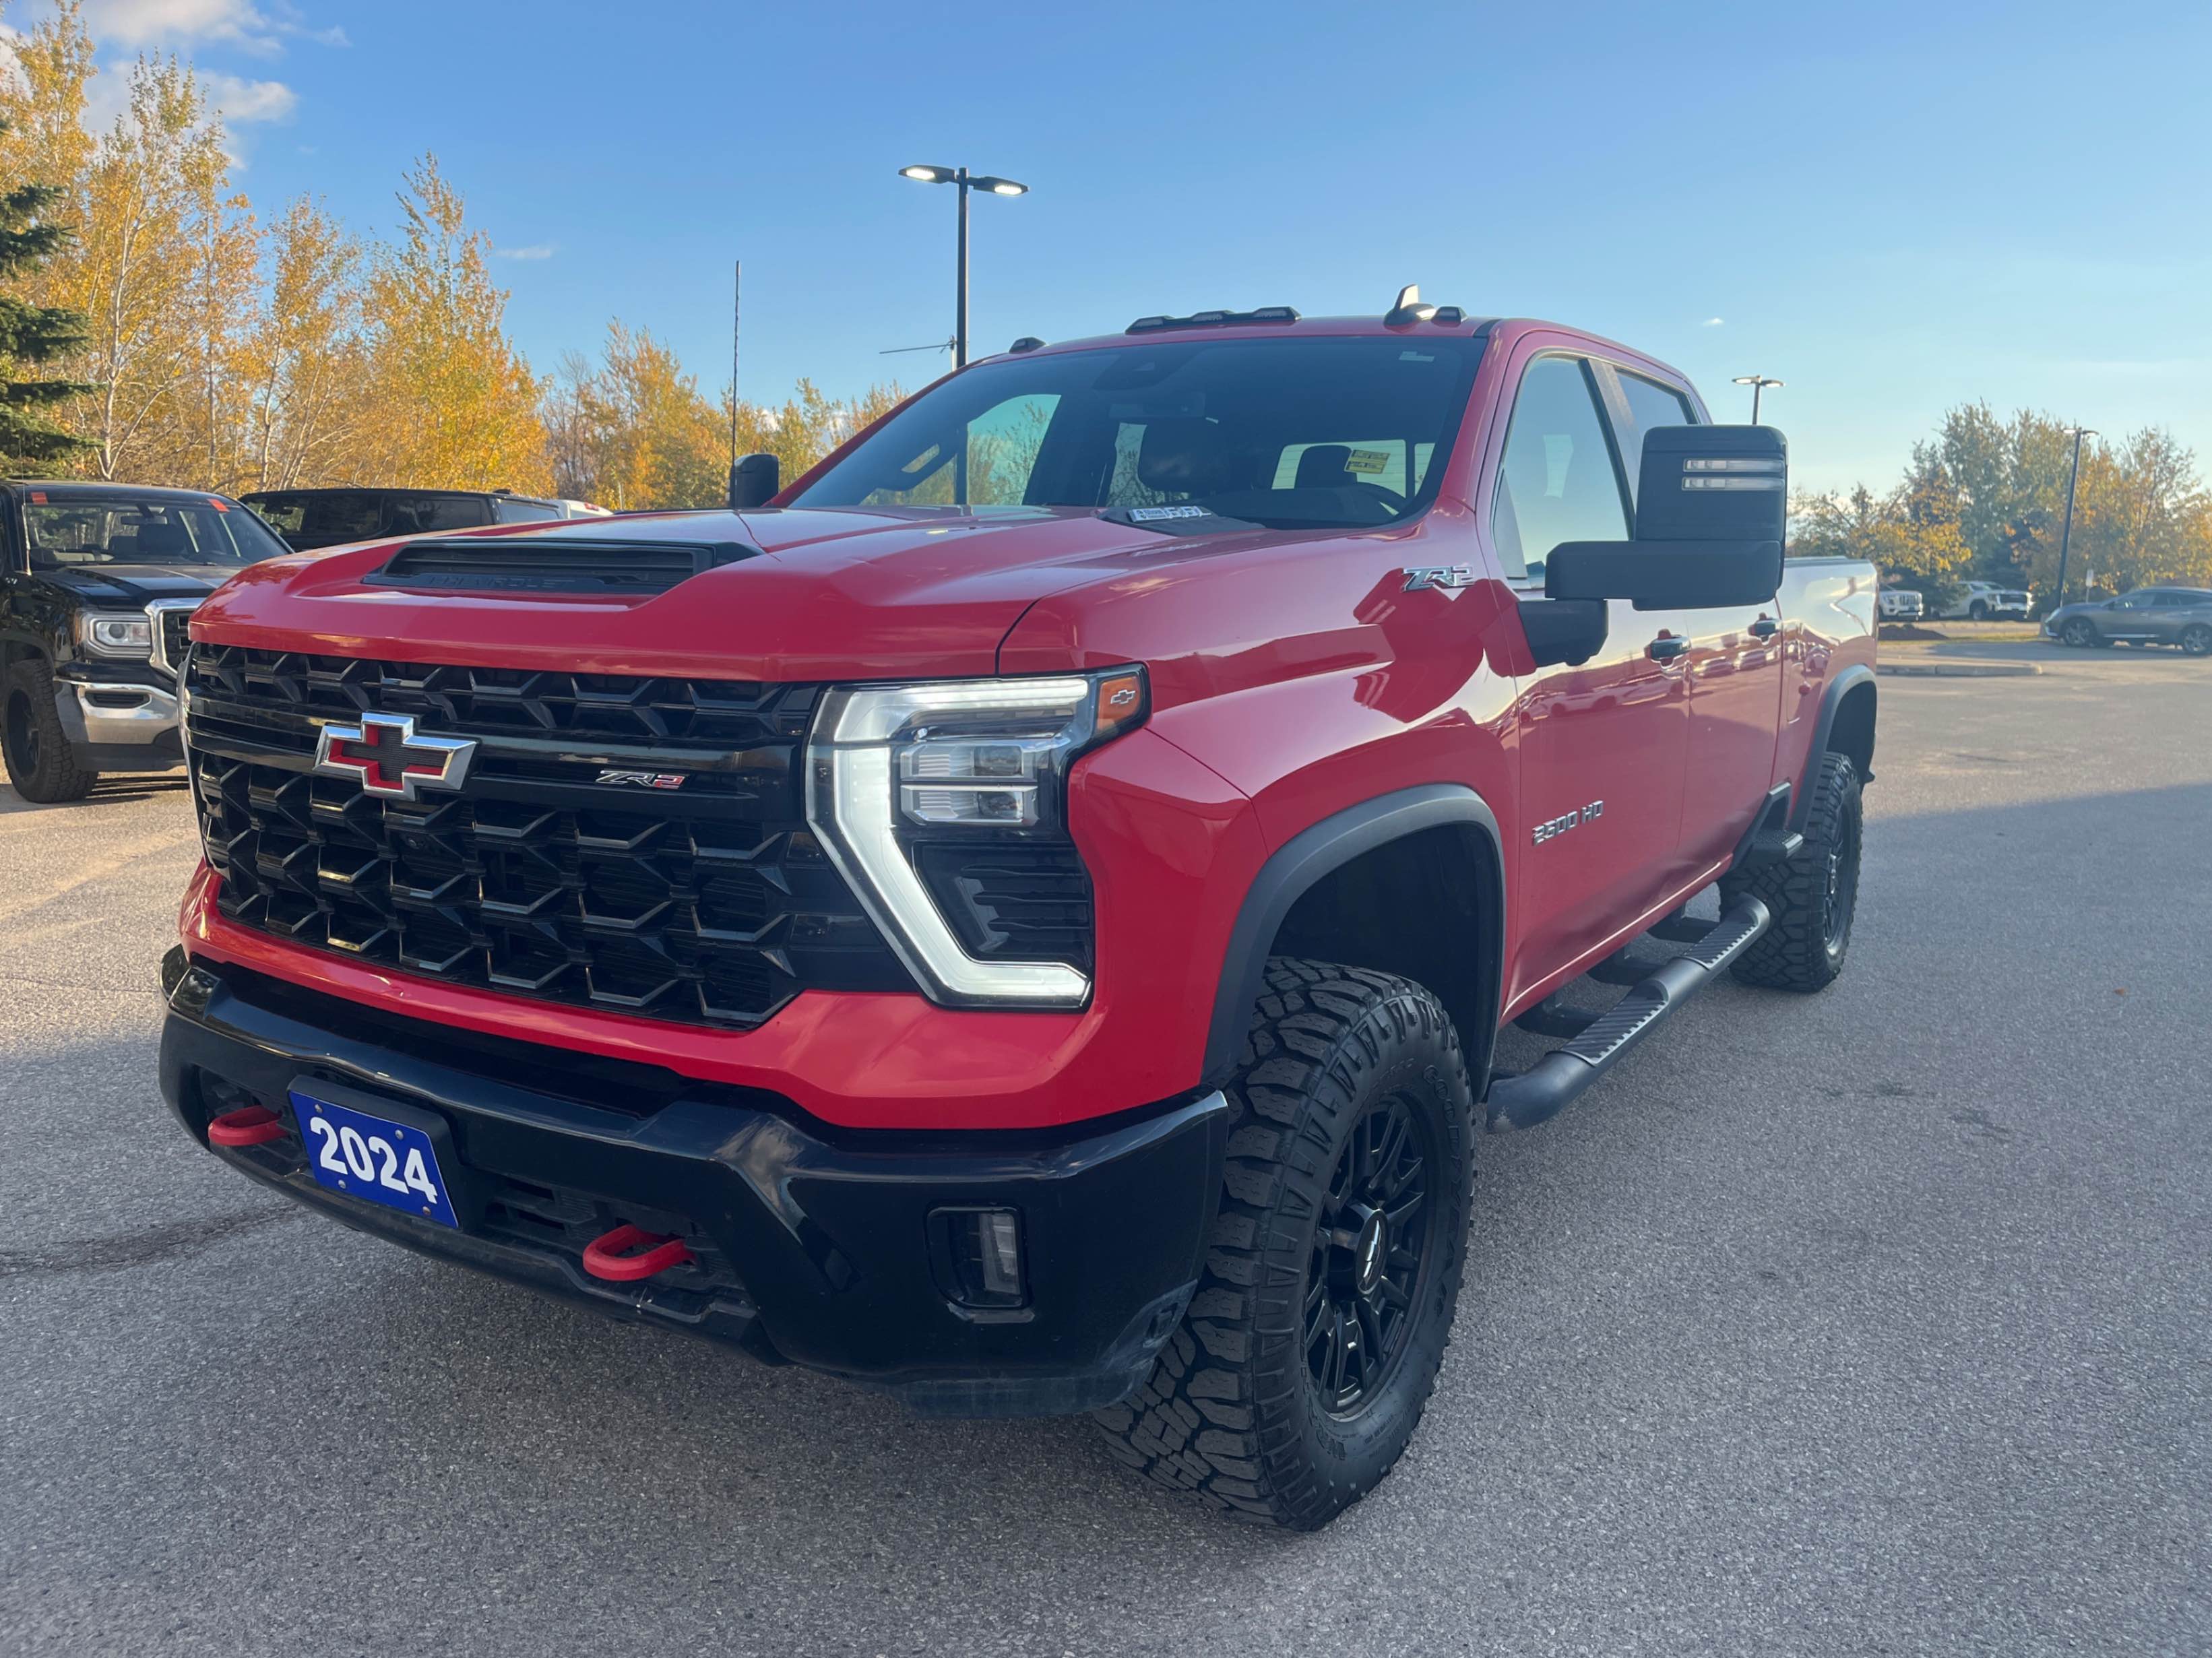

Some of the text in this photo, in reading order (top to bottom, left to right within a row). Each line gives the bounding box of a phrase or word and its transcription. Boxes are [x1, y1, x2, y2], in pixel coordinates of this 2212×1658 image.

[1401, 565, 1476, 593] ZR2
[595, 770, 686, 790] ZR2
[1531, 800, 1604, 847] 2500 HD
[309, 1116, 438, 1205] 2024
